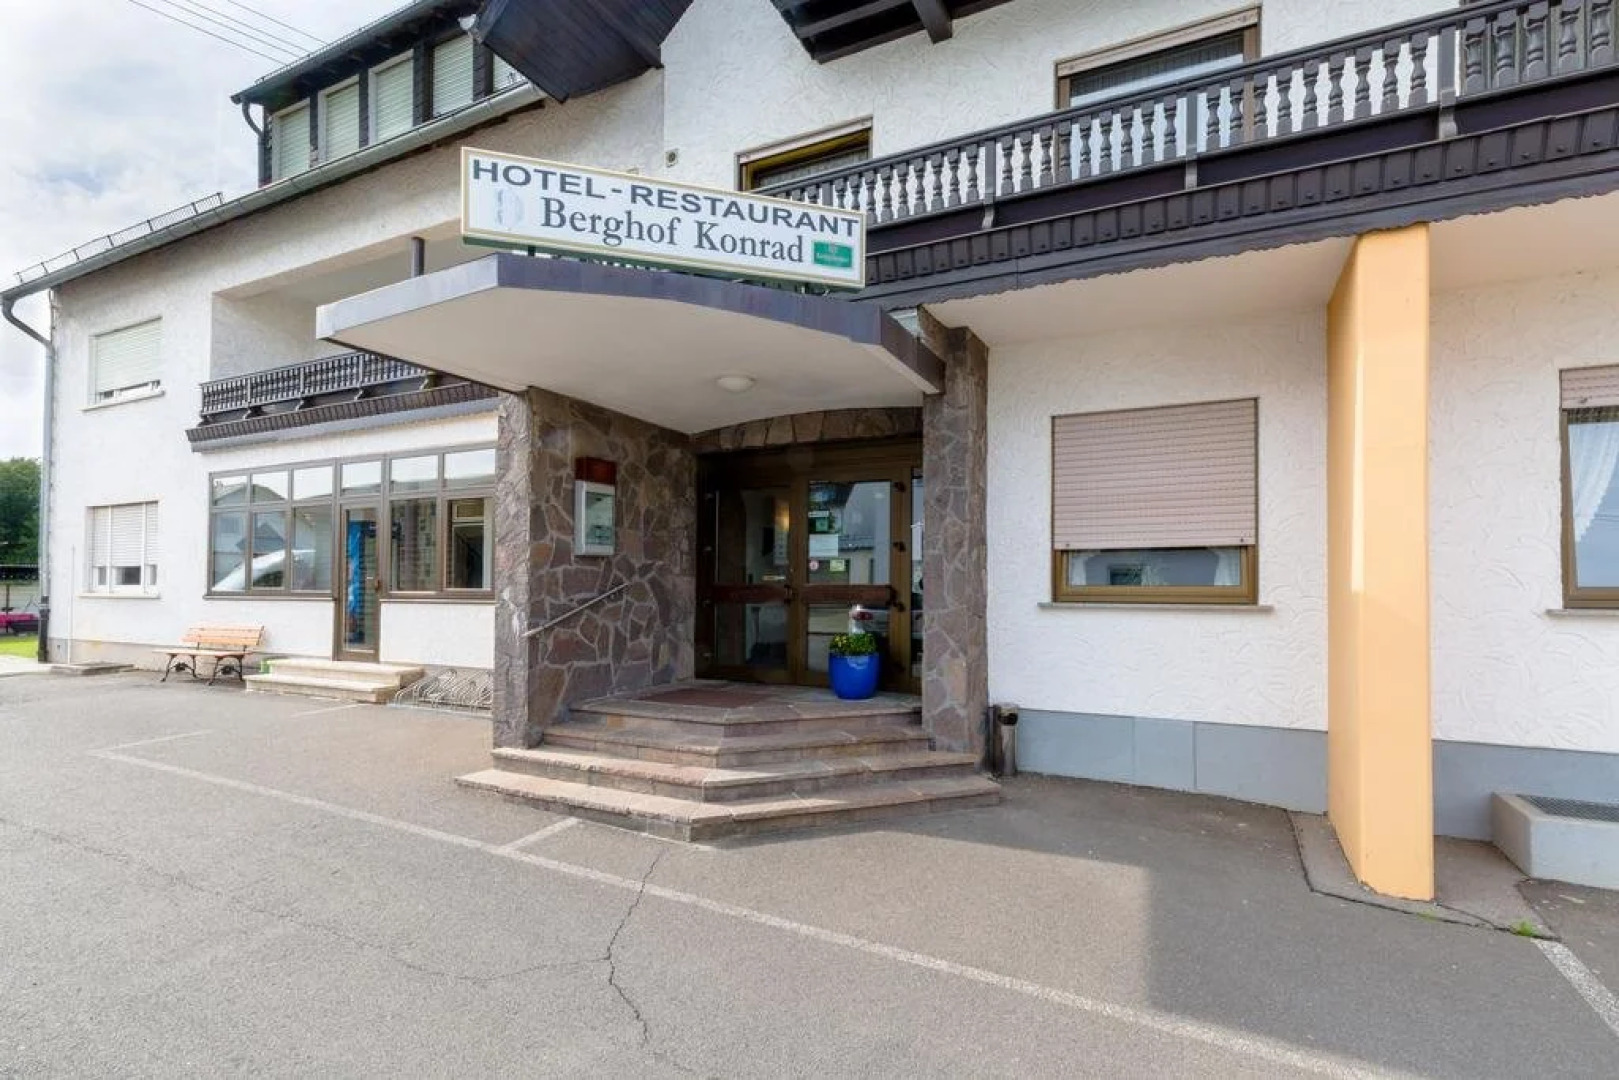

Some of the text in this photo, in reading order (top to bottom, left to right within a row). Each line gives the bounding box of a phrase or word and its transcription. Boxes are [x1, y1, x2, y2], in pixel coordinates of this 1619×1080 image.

[473, 159, 859, 237] HOTEL-RESTAURANT
[540, 197, 804, 263] Berghof Konrad
